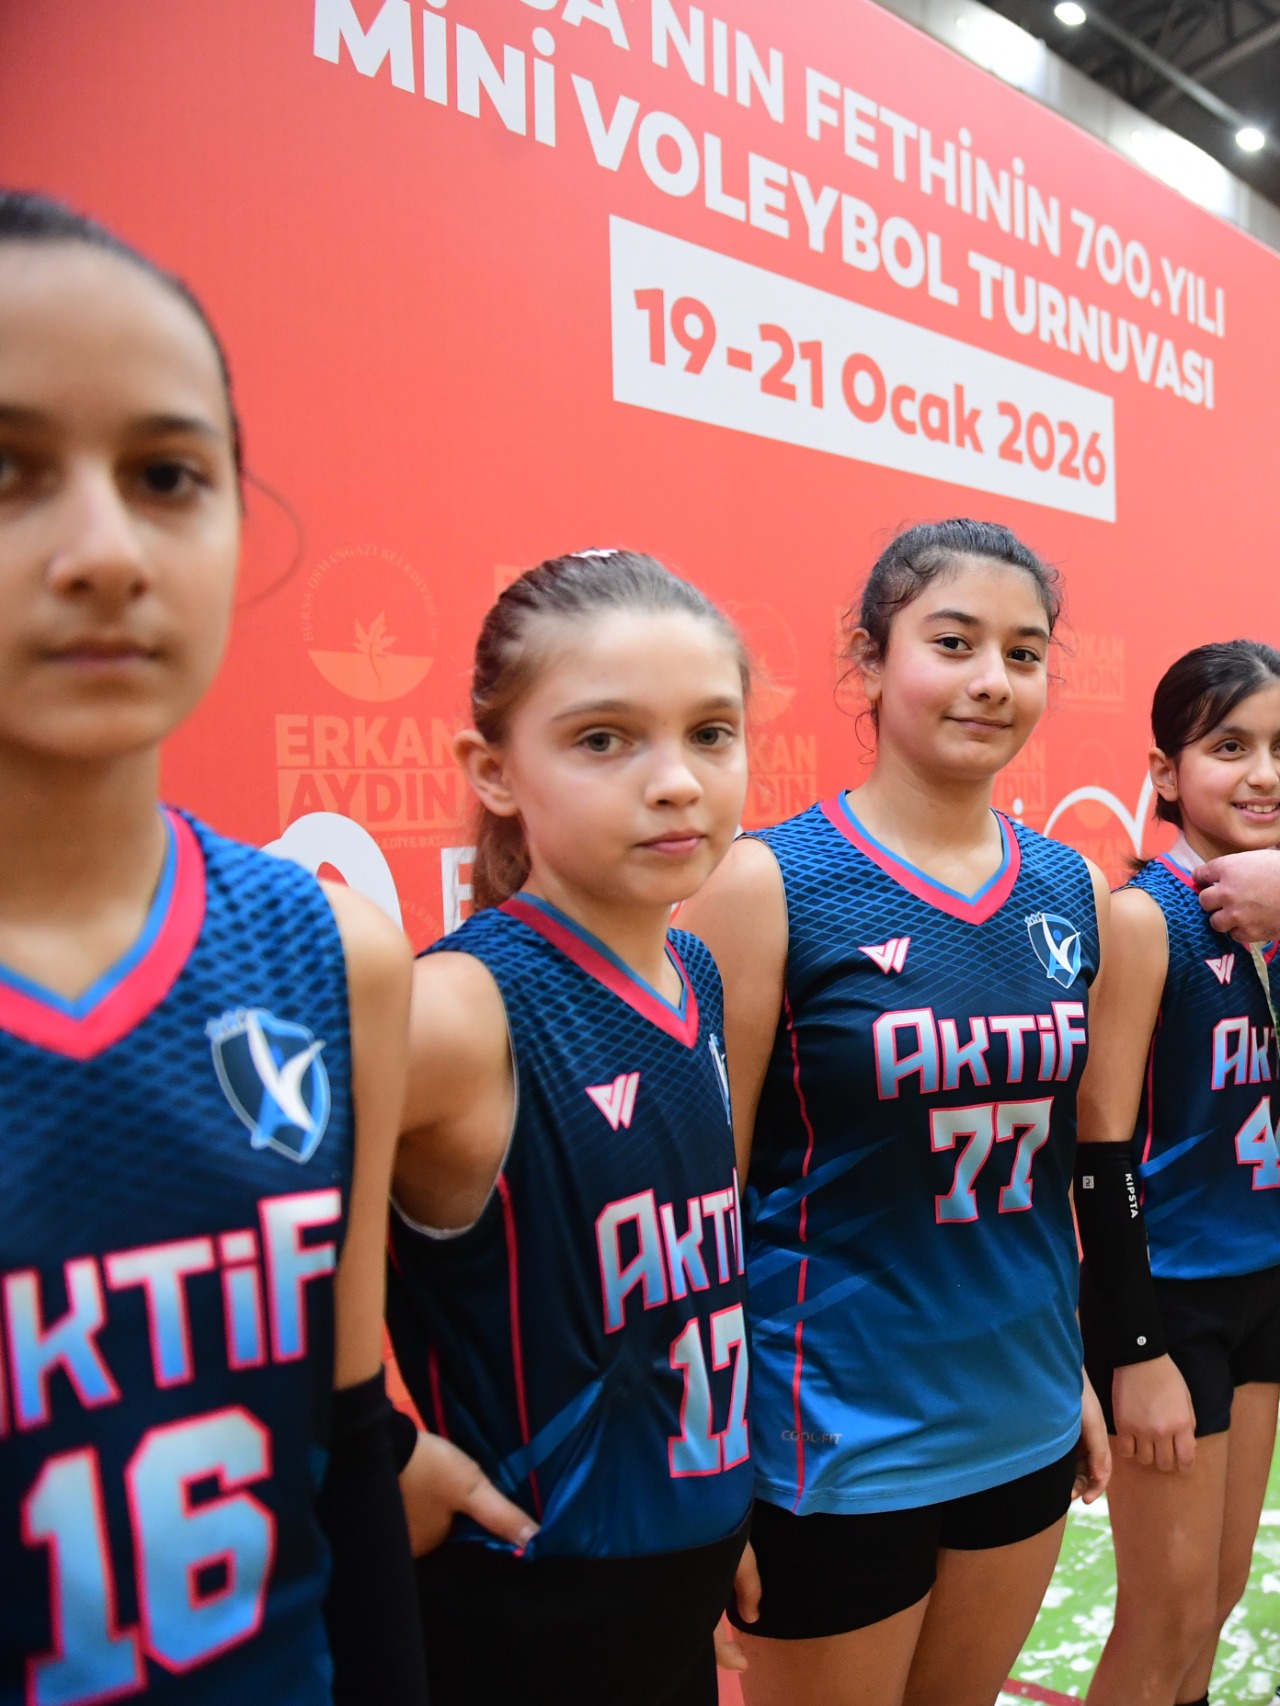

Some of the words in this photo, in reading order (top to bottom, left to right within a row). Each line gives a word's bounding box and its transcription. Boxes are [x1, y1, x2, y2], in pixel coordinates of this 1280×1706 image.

[570, 72, 959, 307] VOLEYBOL
[968, 250, 1215, 411] TURNUVASI
[806, 66, 1061, 257] FETHİNİN
[633, 287, 824, 410] 19-21
[841, 352, 984, 454] Ocak
[996, 400, 1107, 488] 2026
[286, 772, 458, 824] AYDIN
[929, 1096, 1054, 1224] 77
[1124, 1172, 1140, 1219] KIPSTA
[668, 1302, 750, 1478] 17
[20, 1405, 277, 1706] 16
